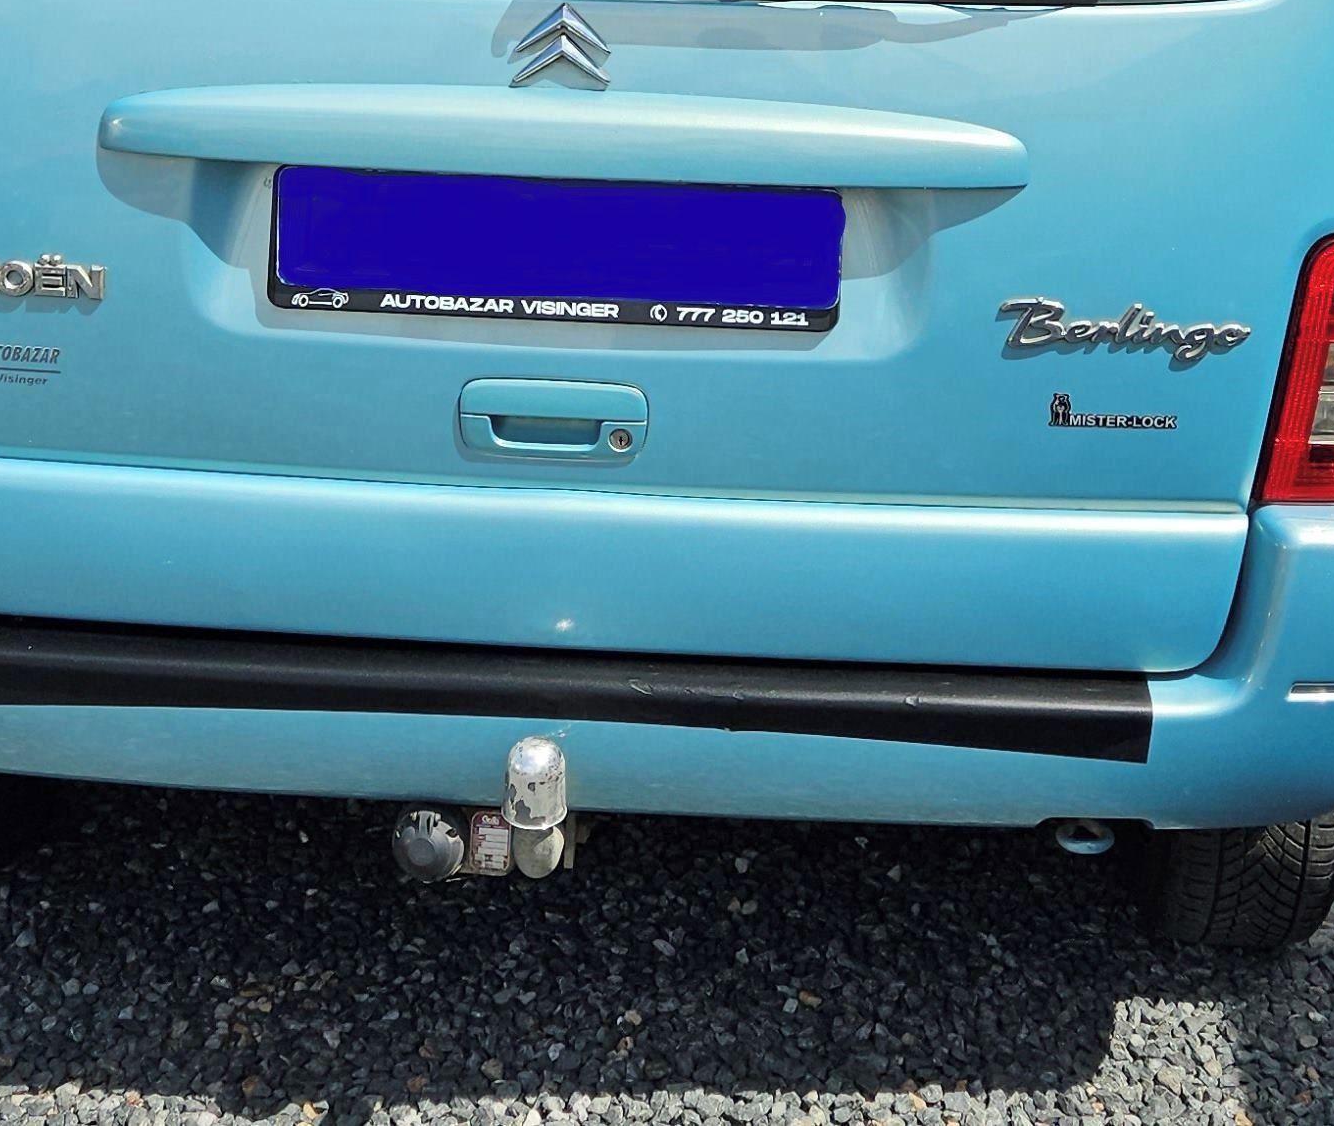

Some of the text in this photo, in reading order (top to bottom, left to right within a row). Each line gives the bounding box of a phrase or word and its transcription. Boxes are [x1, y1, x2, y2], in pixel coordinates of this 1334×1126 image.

[380, 293, 810, 327] AUTOBAZAR VISINGER 777 250 121
[998, 296, 1252, 362] Berlingo
[1069, 413, 1178, 429] MISTER-LOCK
